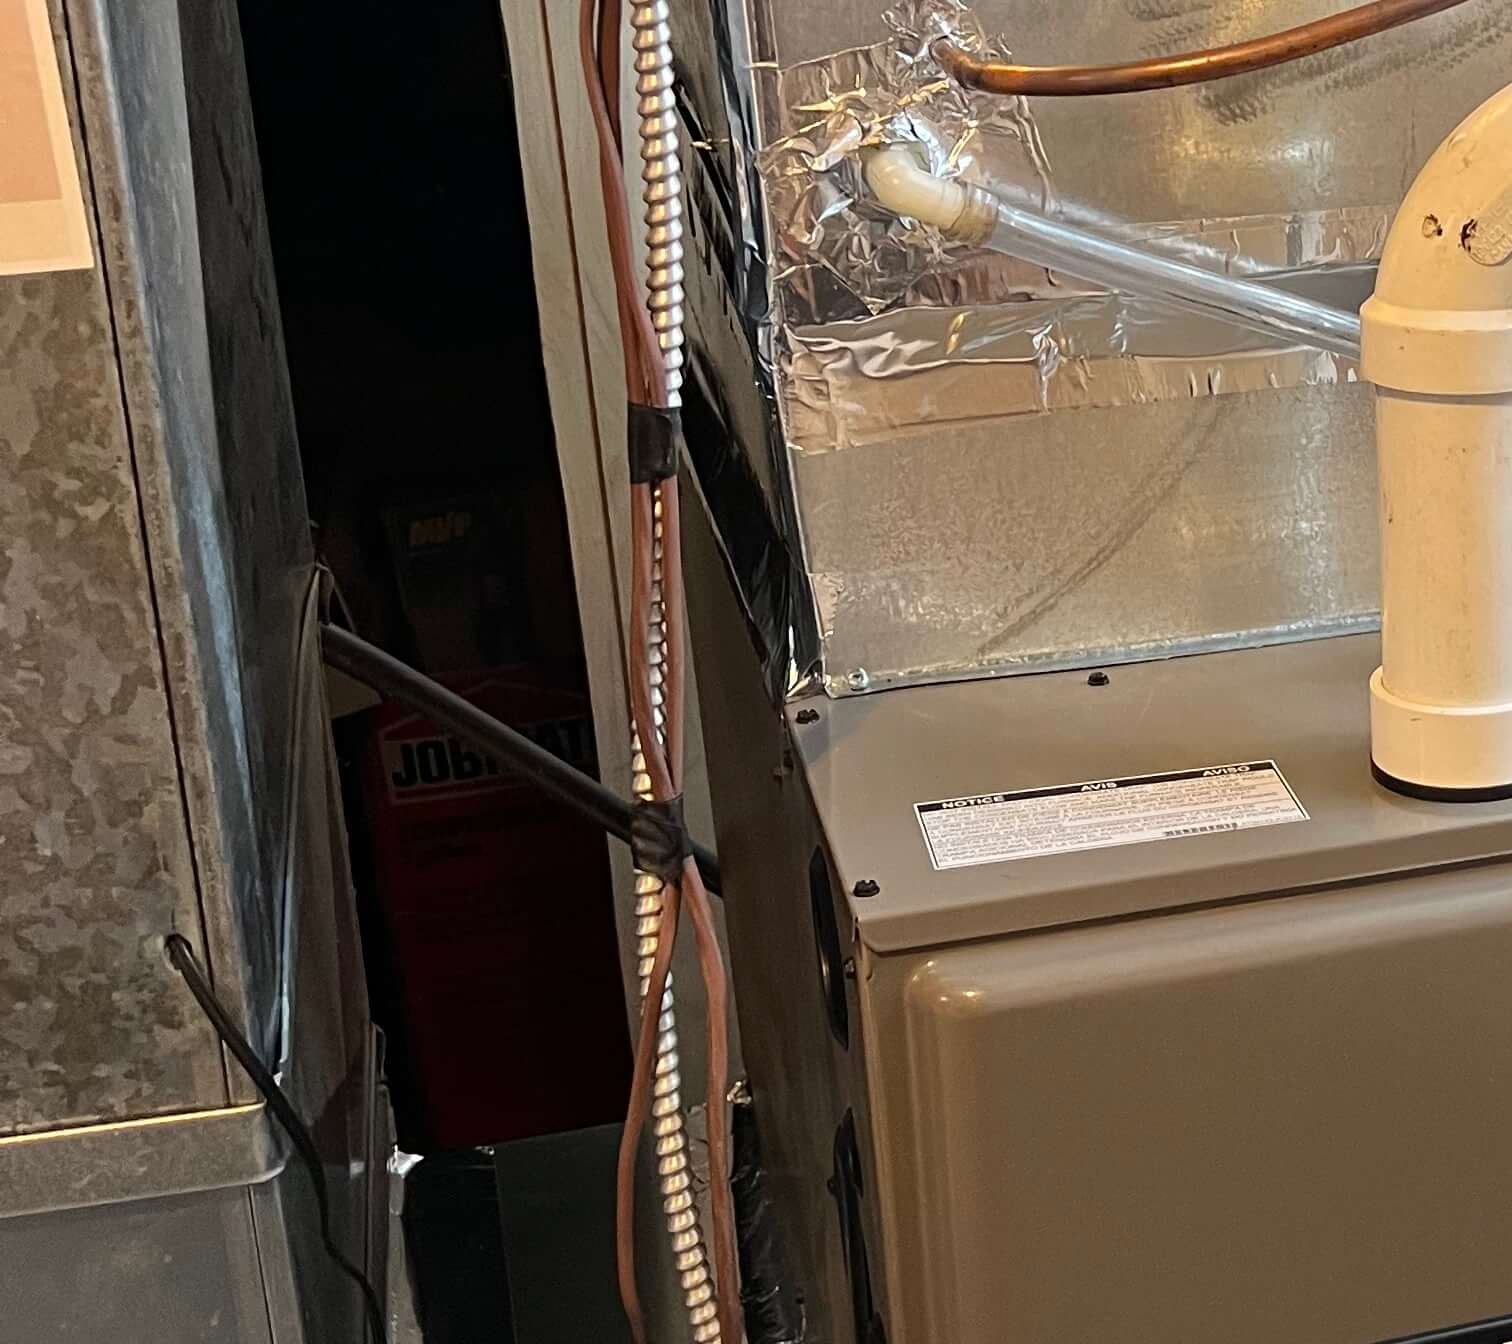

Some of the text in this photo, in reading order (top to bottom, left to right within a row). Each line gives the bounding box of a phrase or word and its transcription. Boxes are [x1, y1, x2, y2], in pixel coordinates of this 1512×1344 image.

[1201, 764, 1251, 777] AVISO
[1080, 781, 1117, 792] AVIS
[941, 794, 1004, 809] NOTICE
